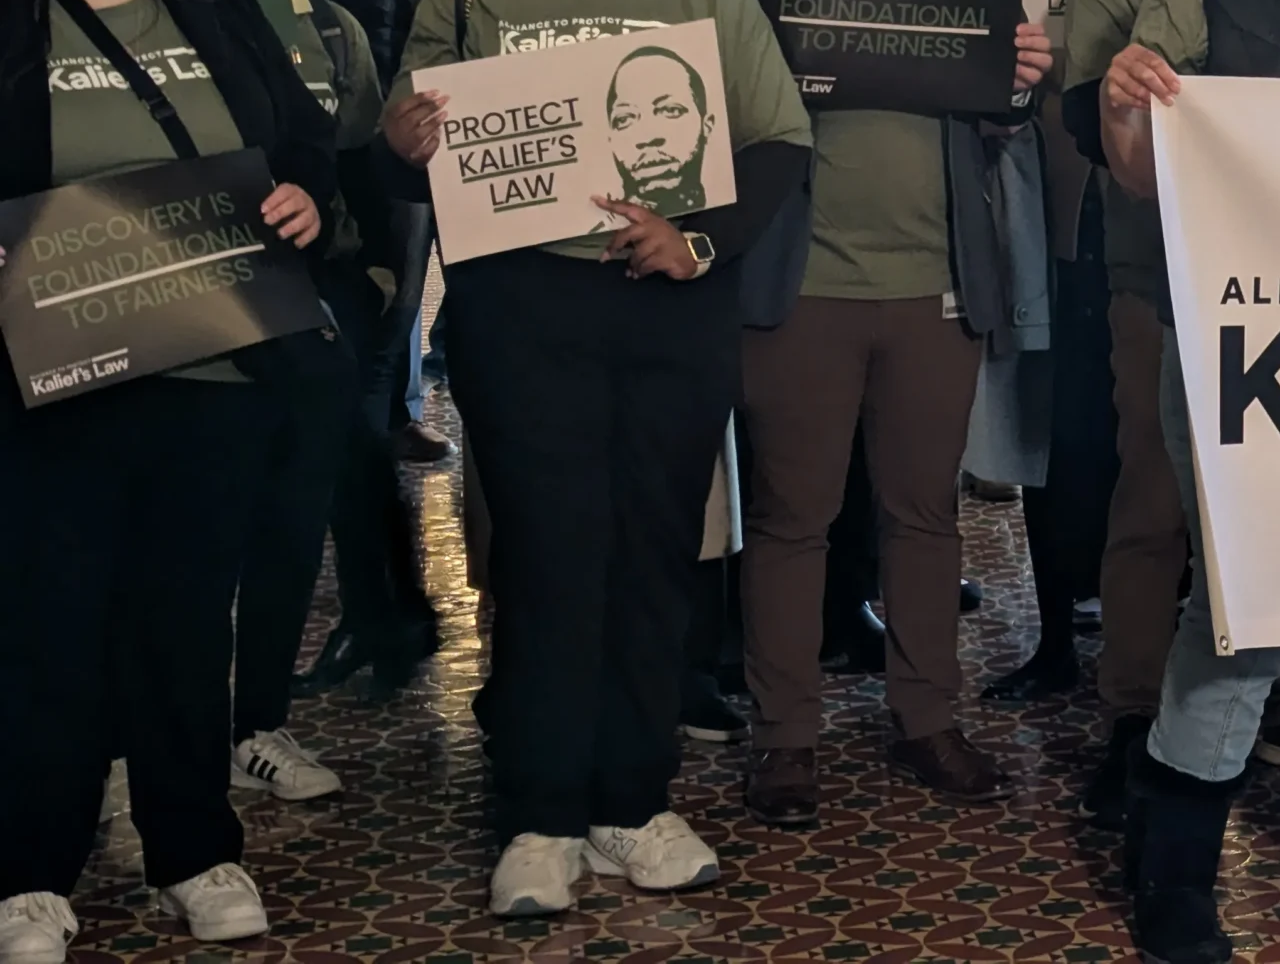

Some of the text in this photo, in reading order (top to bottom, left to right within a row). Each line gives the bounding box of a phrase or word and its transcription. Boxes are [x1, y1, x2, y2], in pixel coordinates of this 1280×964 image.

[553, 18, 569, 27] TO
[572, 16, 622, 26] PROTECT
[798, 27, 967, 59] TO FAIRNESS
[167, 57, 211, 80] La
[802, 80, 833, 94] Law
[443, 97, 579, 145] PROTECT
[457, 134, 577, 177] KALIEF'S
[489, 172, 555, 207] LAW
[30, 191, 235, 263] DISCOVERY IS
[27, 223, 264, 301] FOUNDATIONAL
[61, 258, 254, 329] TO FAIRNESS
[31, 367, 92, 396] Kalief's
[92, 358, 129, 378] Law
